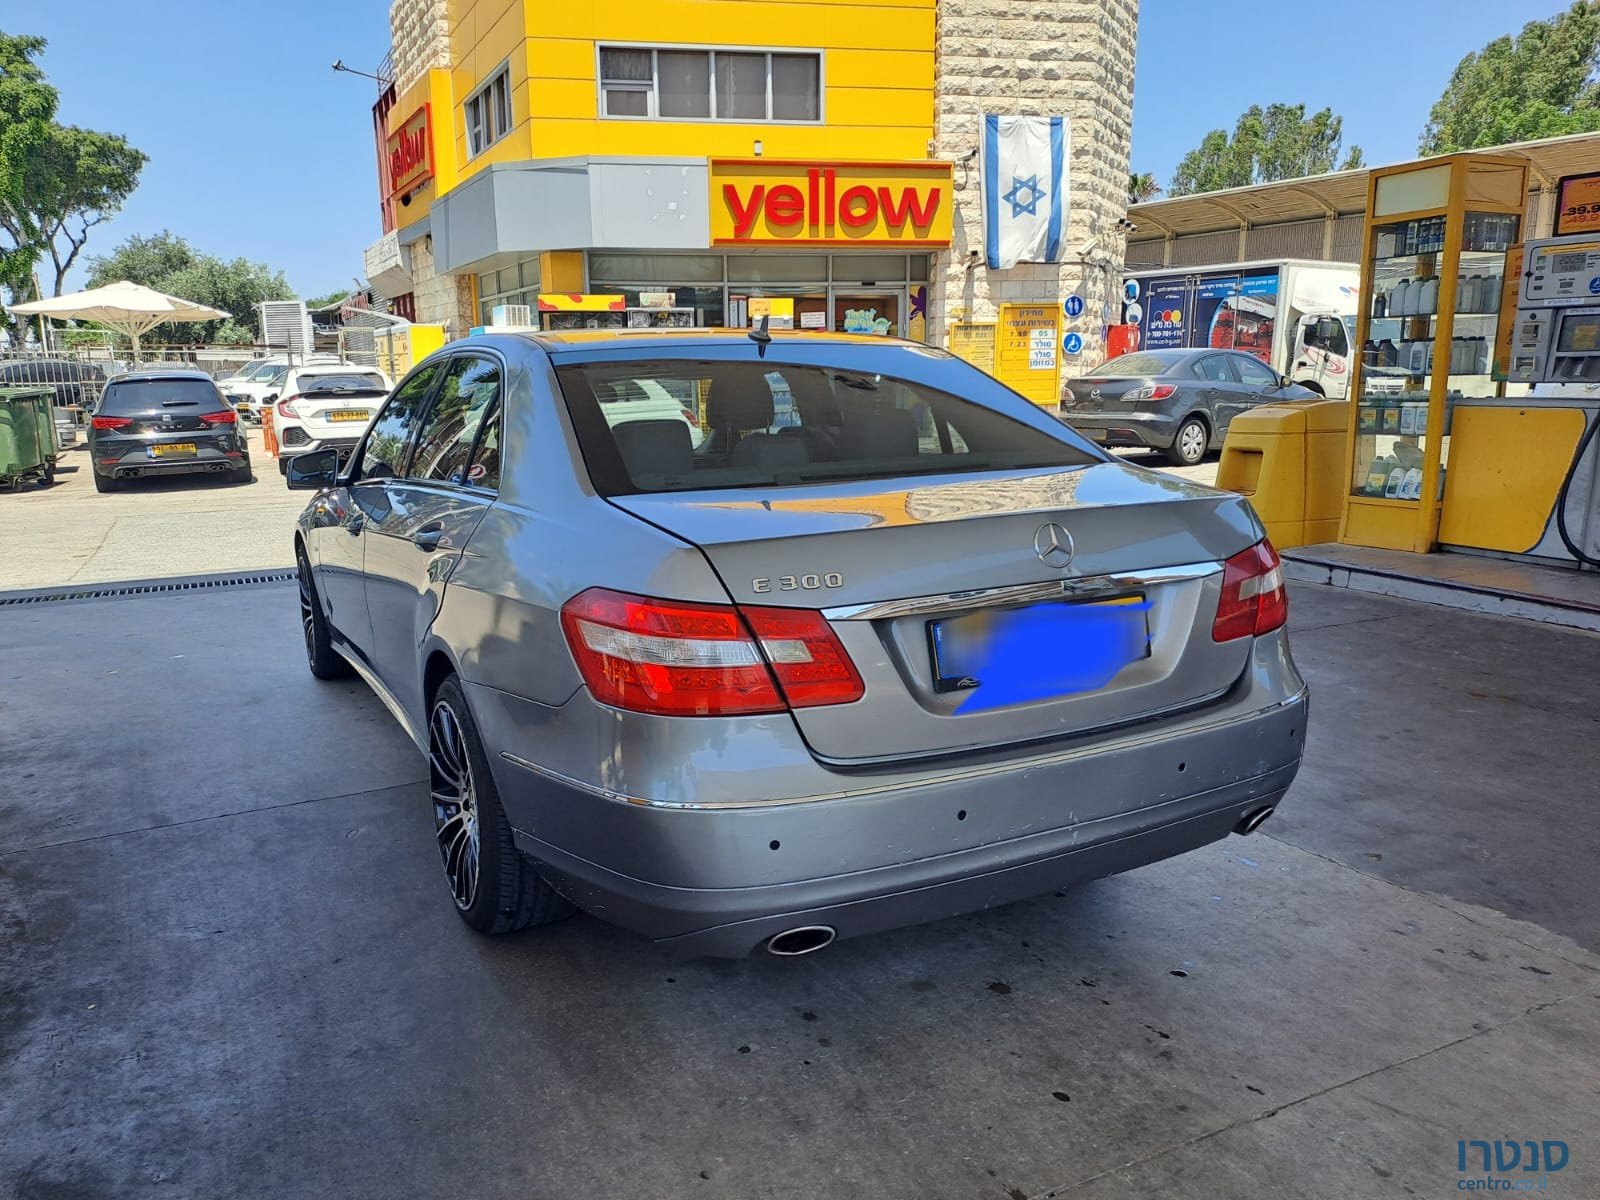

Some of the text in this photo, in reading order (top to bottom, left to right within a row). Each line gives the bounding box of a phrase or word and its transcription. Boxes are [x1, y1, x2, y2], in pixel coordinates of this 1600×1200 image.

[388, 126, 426, 192] yellow
[722, 167, 941, 239] yellow
[1019, 309, 1044, 318] מחירון
[1034, 350, 1052, 358] סולר
[1030, 359, 1055, 367] במזומן
[752, 571, 844, 593] E 300
